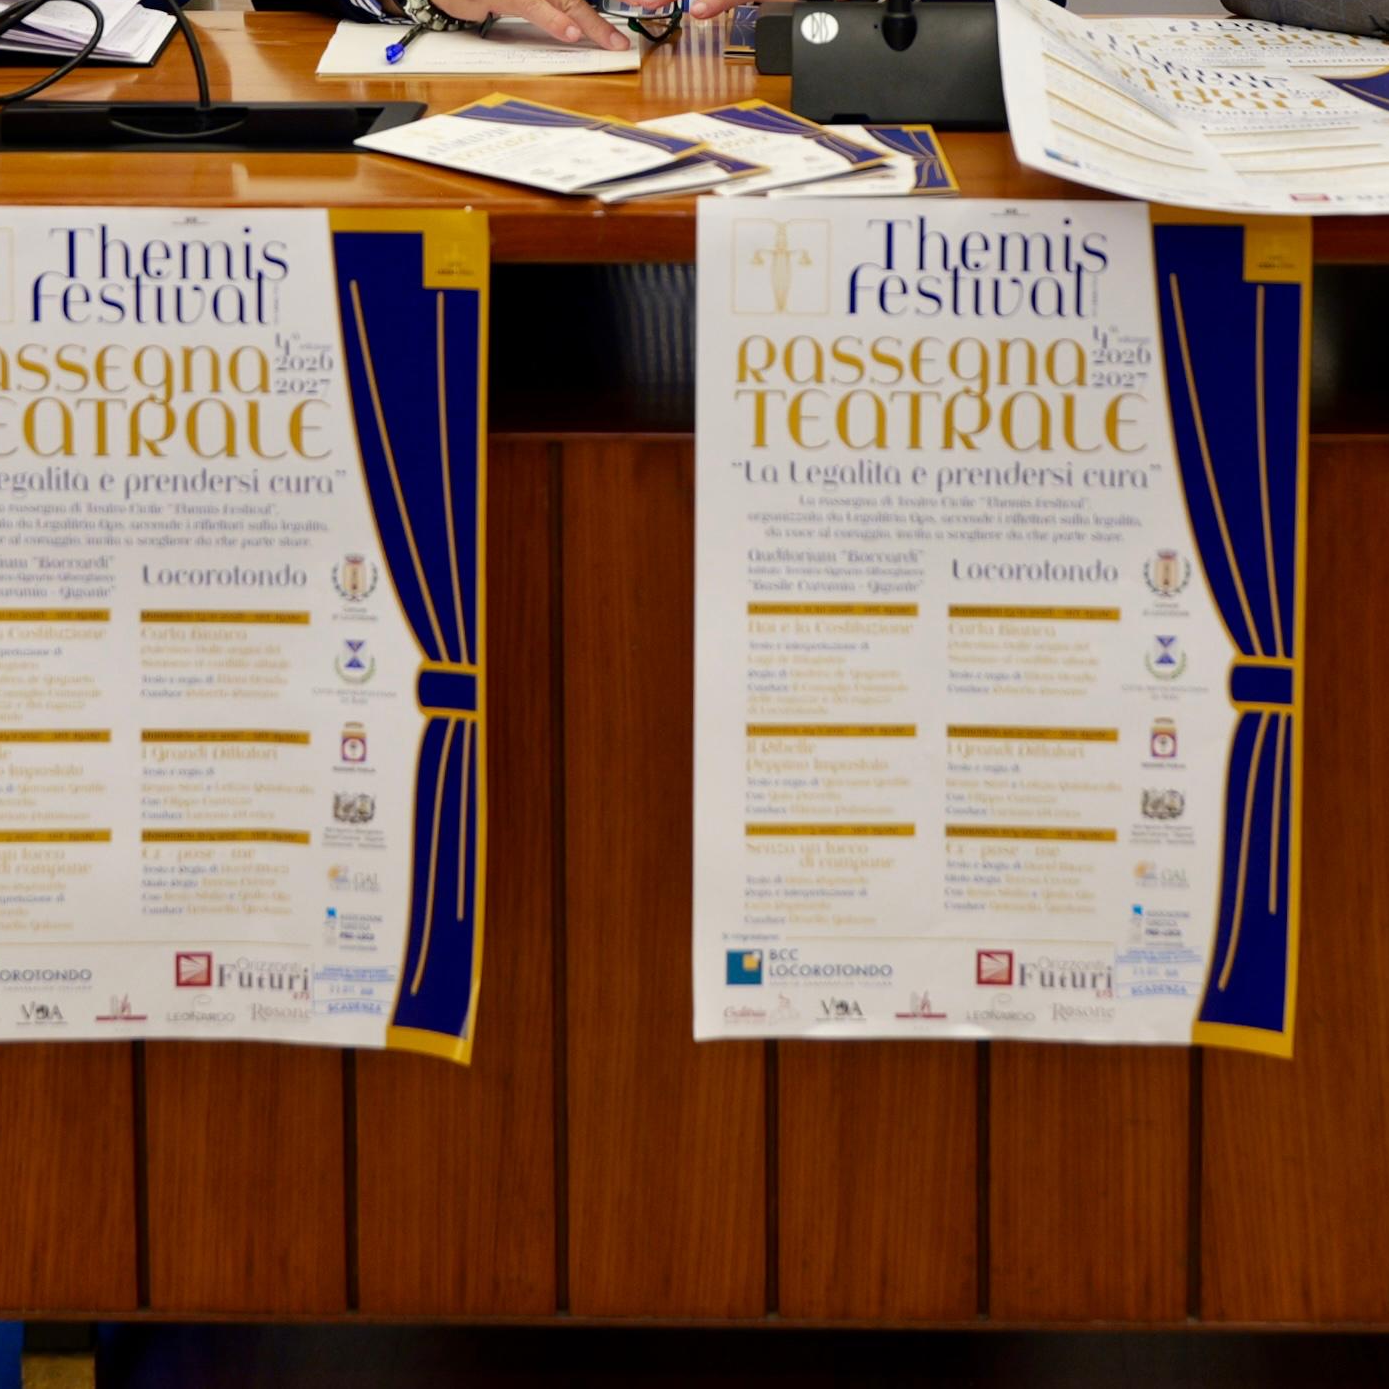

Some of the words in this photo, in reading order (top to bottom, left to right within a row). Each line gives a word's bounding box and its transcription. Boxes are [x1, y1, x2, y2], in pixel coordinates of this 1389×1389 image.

[49, 224, 290, 282] Themis
[868, 216, 1109, 274] Themis
[30, 270, 270, 325] festival
[846, 261, 1088, 318] festival
[275, 352, 334, 372] 2026
[1092, 346, 1151, 366] 2026
[275, 378, 332, 396] 2027
[1092, 371, 1149, 389] 2027
[124, 468, 259, 499] prendersi
[937, 462, 1073, 493] prendersi
[142, 564, 308, 587] Locorotondo
[952, 559, 1119, 583] Locorotondo
[768, 948, 799, 962] BCC
[217, 963, 309, 991] Futuri
[768, 963, 893, 978] LOCOROTONDO
[1018, 961, 1114, 990] Futuri
